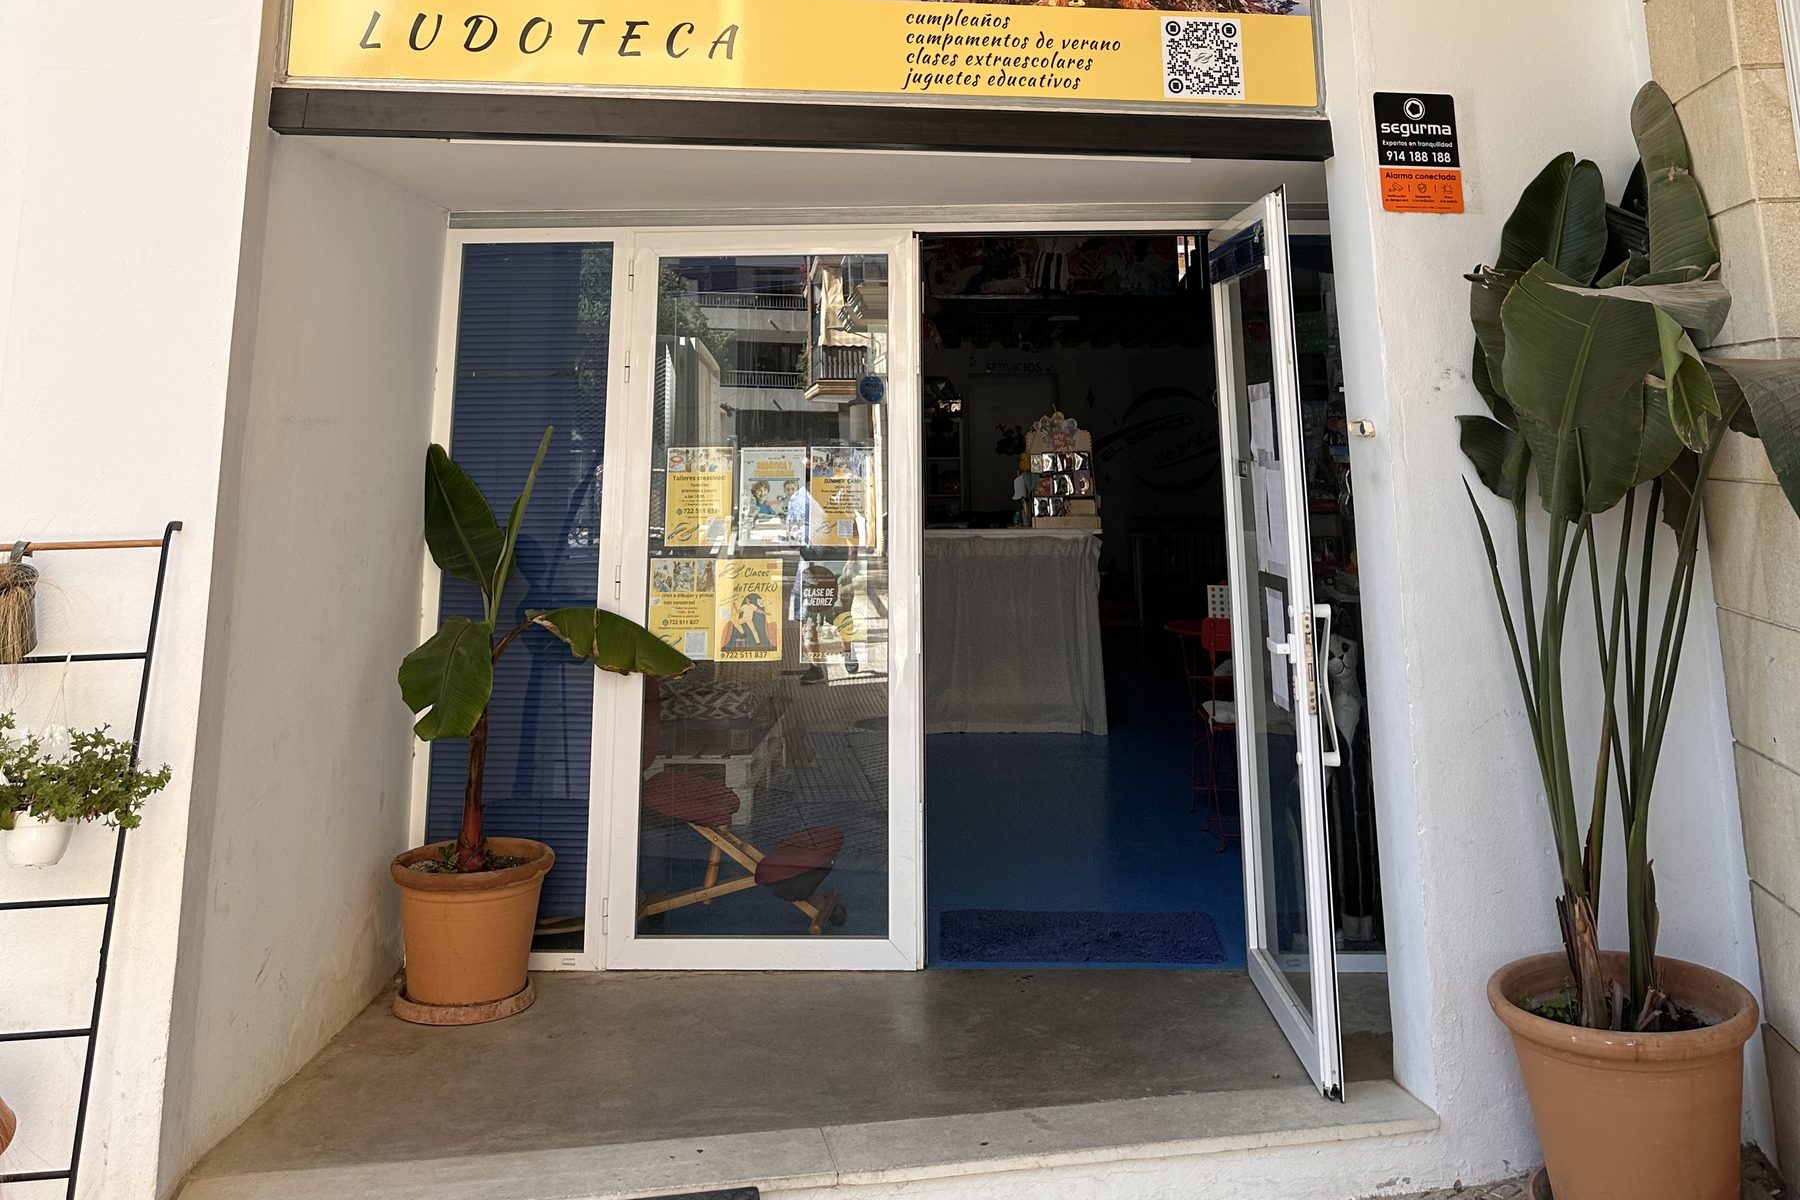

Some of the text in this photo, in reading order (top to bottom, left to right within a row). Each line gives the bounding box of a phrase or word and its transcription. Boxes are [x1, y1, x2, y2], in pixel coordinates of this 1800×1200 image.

[905, 8, 1012, 30] cumpleaños
[358, 9, 740, 61] LUDOTECA
[905, 30, 1122, 52] campamentos de verano
[905, 46, 1095, 72] clases extraescolares
[901, 67, 1082, 91] juguetes educativos
[1380, 122, 1452, 138] segurma
[1382, 139, 1408, 148] Expertos
[1417, 140, 1454, 149] tranquilidad
[1386, 150, 1452, 163] 914 188 188
[1385, 171, 1457, 181] Alarma conectada
[744, 567, 771, 577] Clases
[803, 588, 835, 597] CLASE DE
